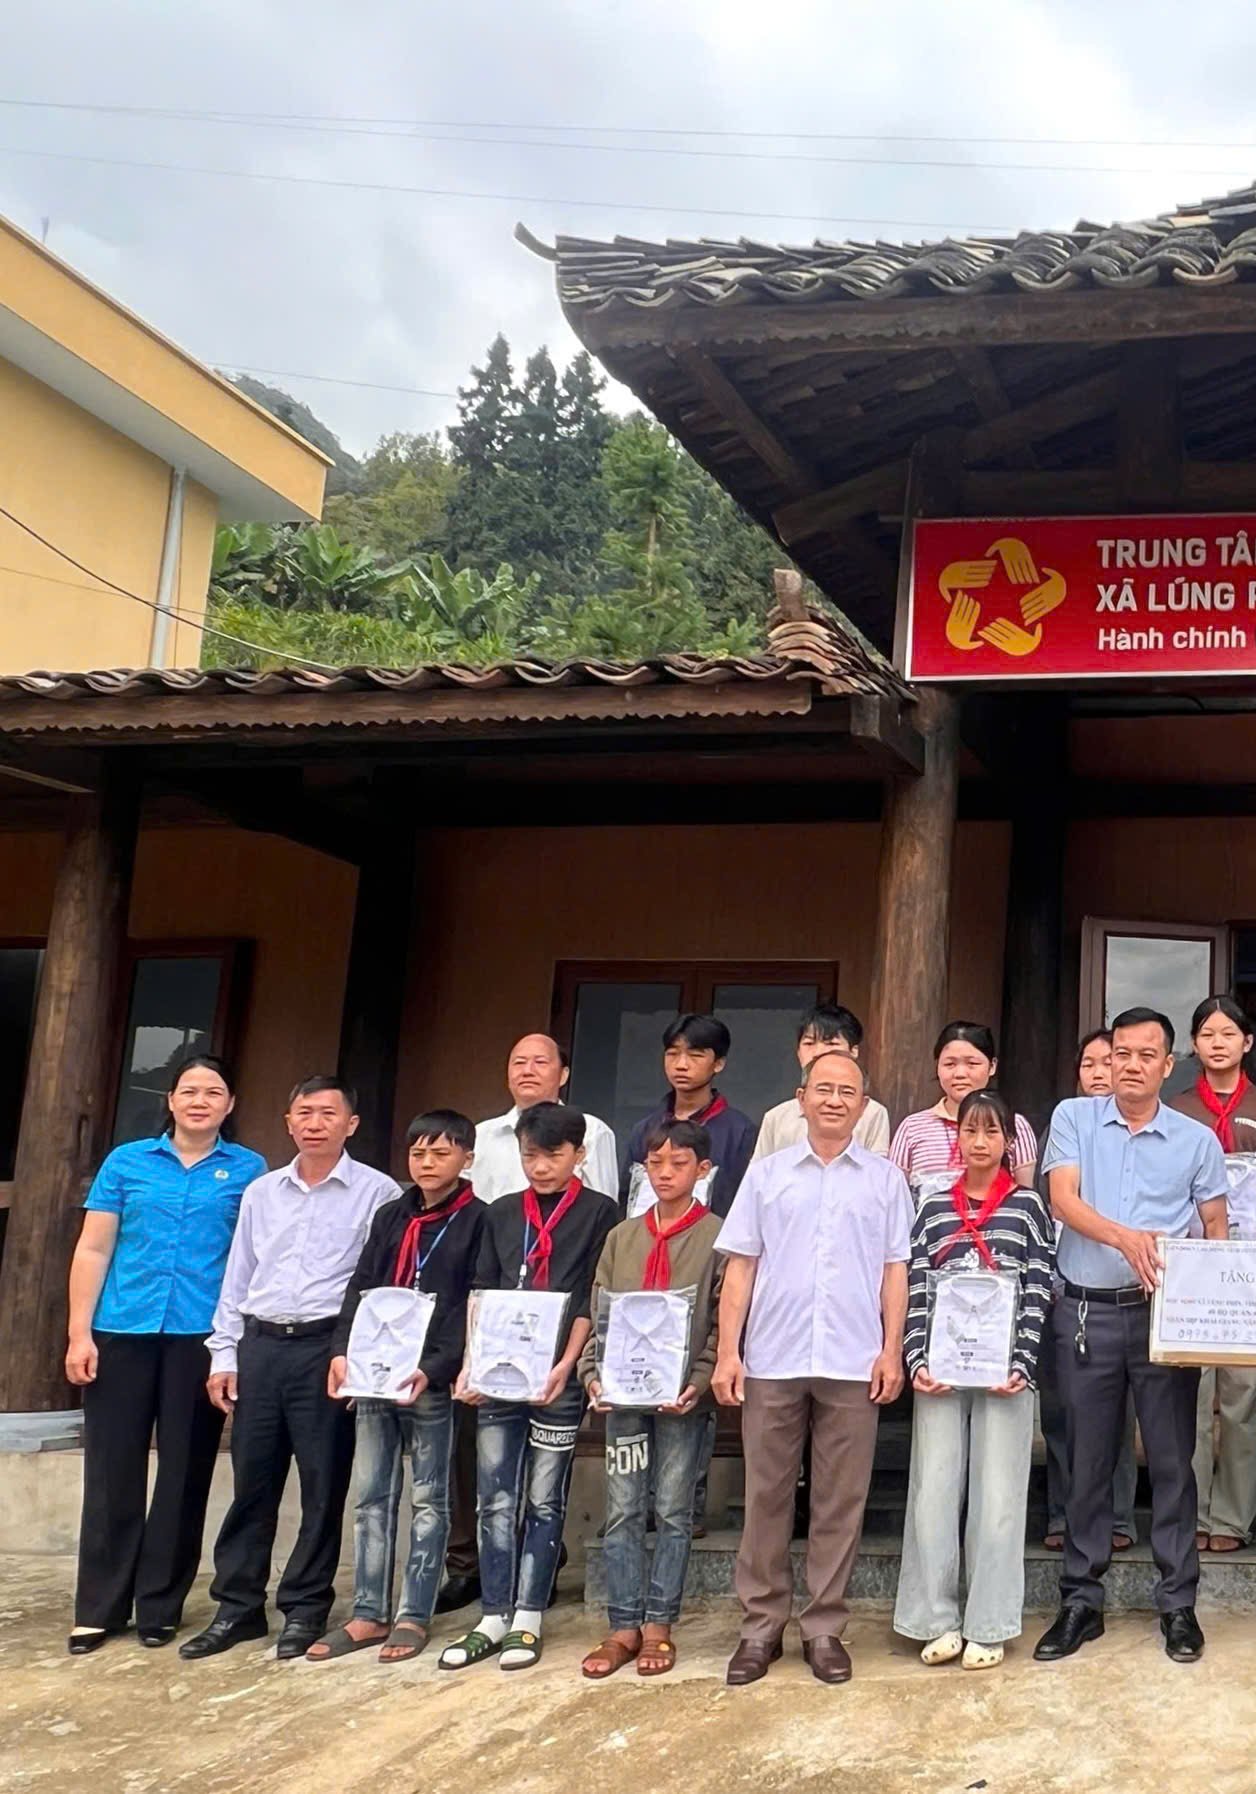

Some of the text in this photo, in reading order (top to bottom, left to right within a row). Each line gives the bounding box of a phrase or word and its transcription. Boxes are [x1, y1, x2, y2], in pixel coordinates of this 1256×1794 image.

[1096, 537, 1206, 568] TRUNG
[1095, 577, 1138, 612] XÃ
[1148, 576, 1235, 612] LÚNG
[1098, 627, 1163, 650] Hành
[1172, 625, 1246, 649] chính
